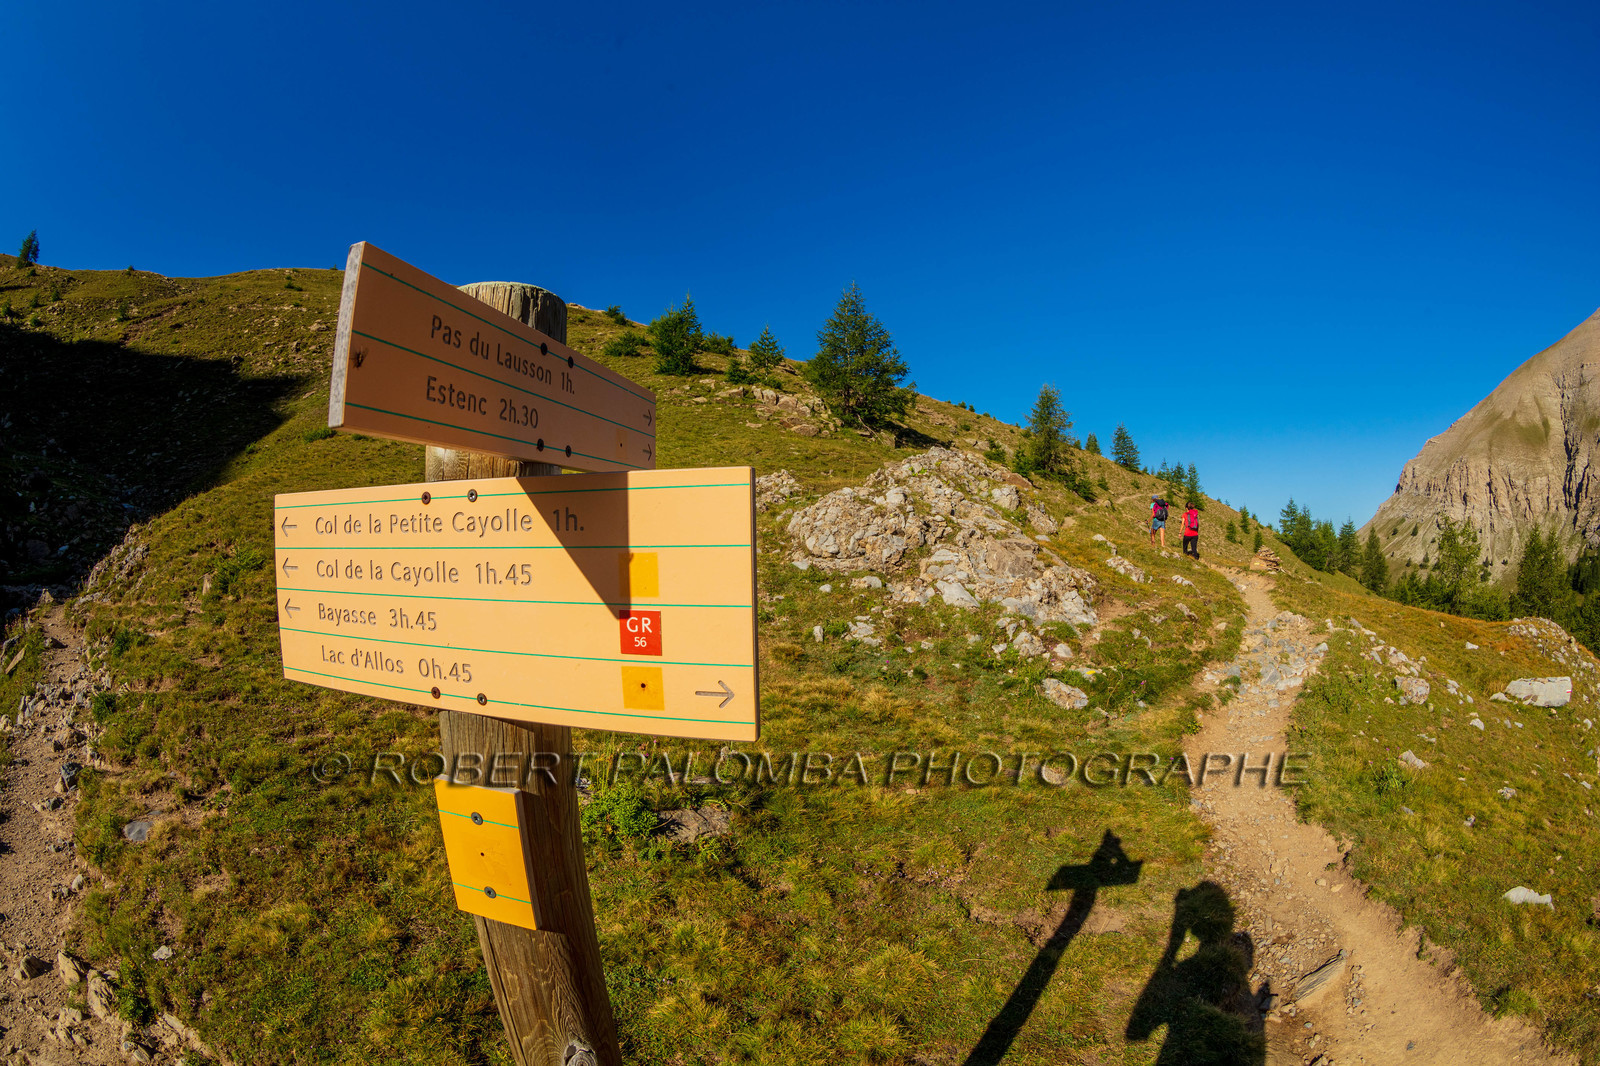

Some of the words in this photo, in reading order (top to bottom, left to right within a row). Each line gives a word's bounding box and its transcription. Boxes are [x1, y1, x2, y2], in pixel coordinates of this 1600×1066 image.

[430, 314, 462, 349] Pas
[469, 331, 490, 361] du
[497, 342, 552, 386] Lausson
[560, 371, 576, 395] 1h.
[426, 375, 488, 416] Estenc
[499, 398, 539, 429] 2h.30
[315, 515, 338, 536] Col
[343, 514, 362, 534] de
[368, 513, 382, 534] la
[389, 512, 443, 534] Petite
[451, 508, 533, 538] Cayolle
[552, 506, 585, 533] 1h.
[316, 559, 339, 580] Col
[345, 559, 364, 580] de
[369, 559, 384, 581] la
[390, 560, 460, 587] Cayolle
[475, 562, 533, 586] 1h.45
[318, 602, 377, 627] Bayasse
[388, 607, 438, 631] 3h.45
[626, 616, 653, 634] GR
[633, 636, 647, 648] 56
[321, 645, 345, 666] Lac
[418, 658, 473, 684] 0h.45
